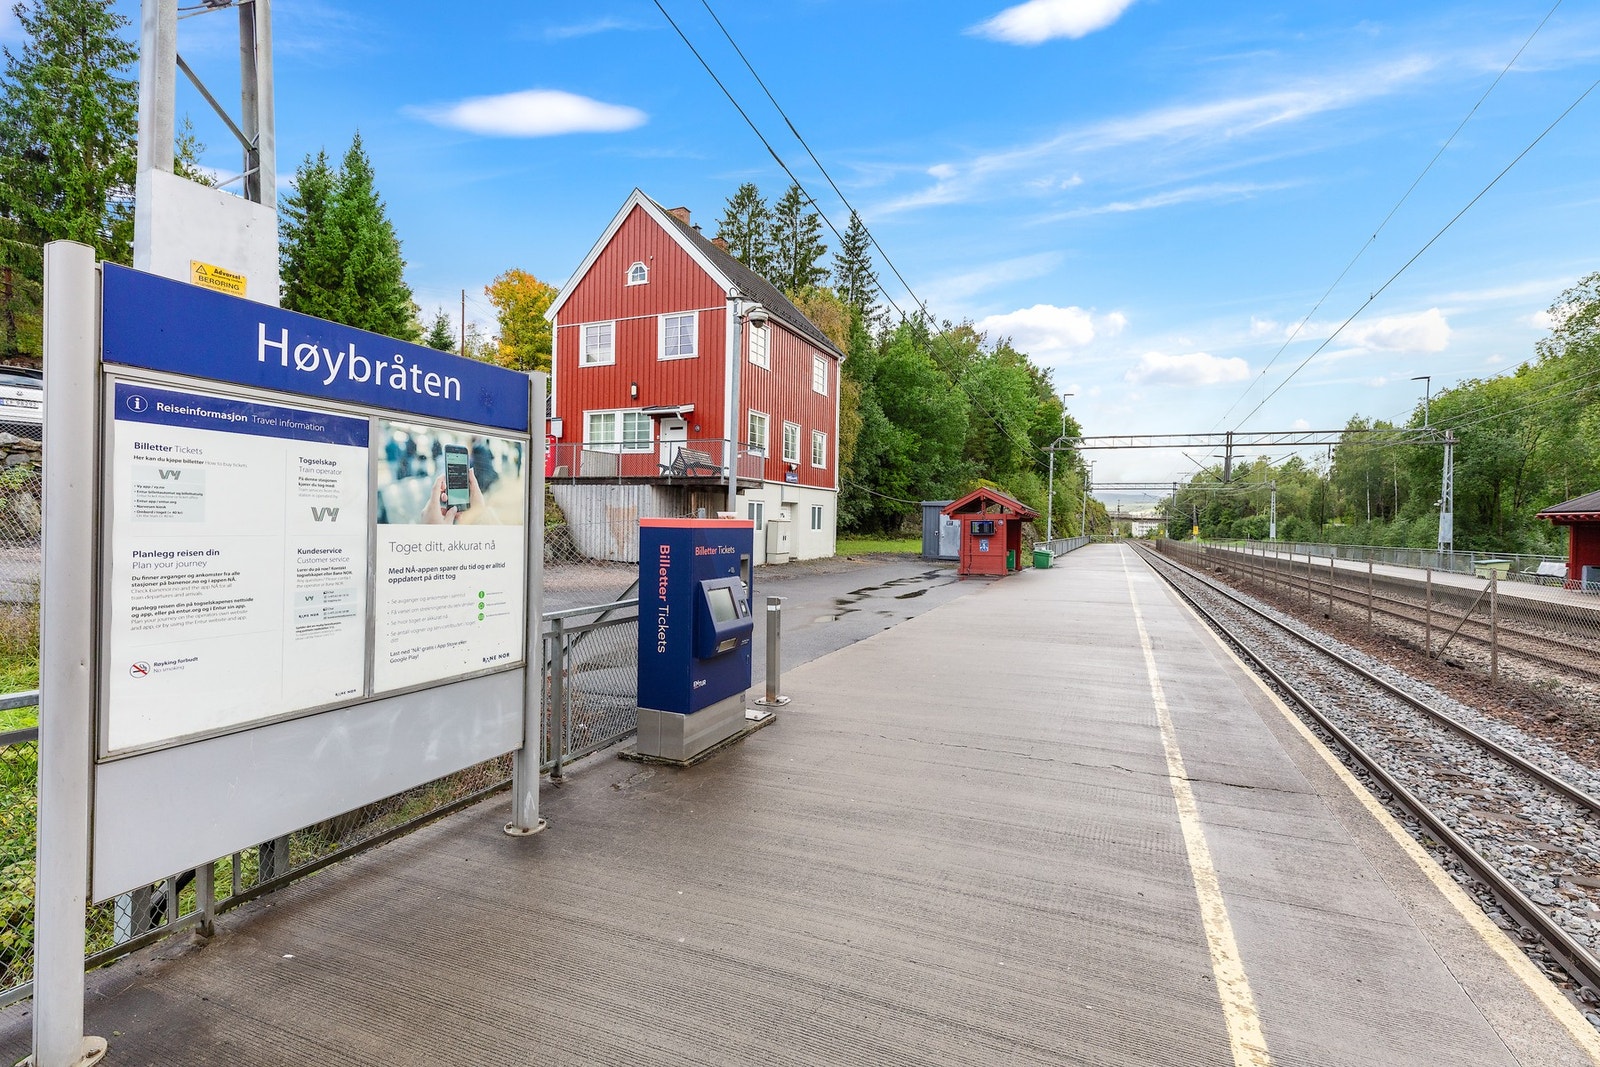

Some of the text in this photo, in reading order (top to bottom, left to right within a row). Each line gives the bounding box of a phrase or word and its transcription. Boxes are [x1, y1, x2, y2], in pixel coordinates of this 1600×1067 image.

[258, 322, 461, 401] Høybråten
[156, 402, 325, 432] Reiseinformasjon Travel information
[134, 442, 203, 455] Billetter Tickets
[299, 457, 336, 467] Togselskap
[389, 540, 496, 556] Toget ditt, akkurat nå
[695, 546, 735, 555] Billetter Tickets
[132, 550, 174, 559] Planlegg
[154, 562, 173, 570] your
[175, 560, 207, 569] journey
[388, 575, 422, 584] oppdatert
[658, 545, 670, 653] Billetter Tickets
